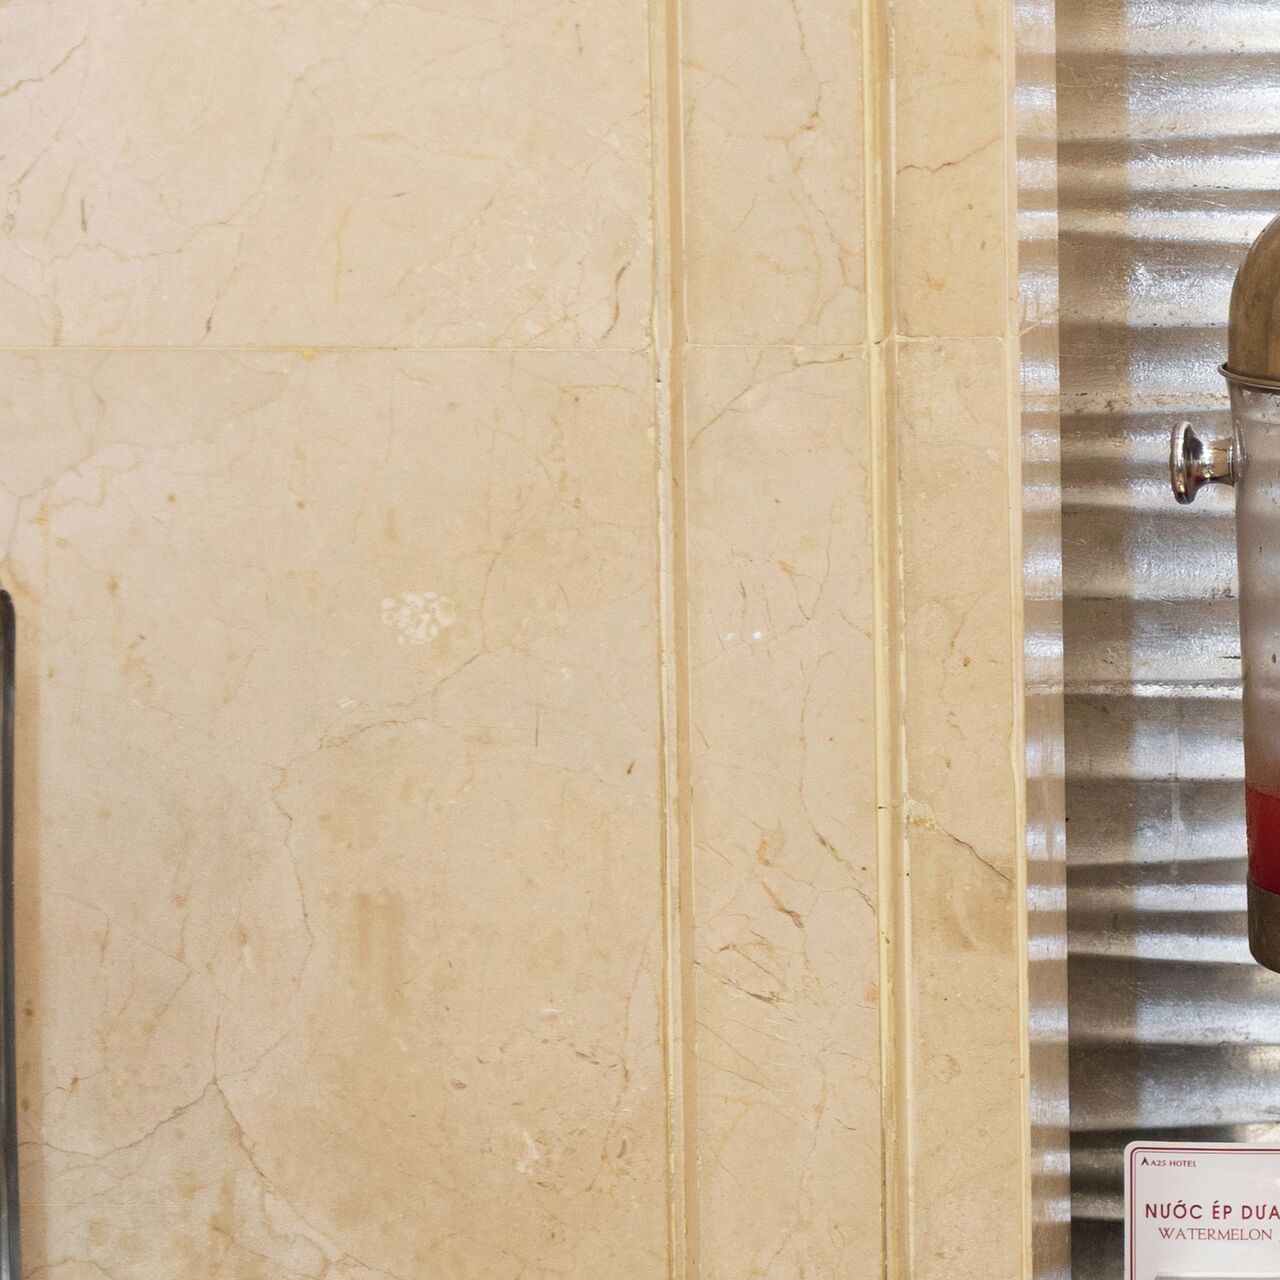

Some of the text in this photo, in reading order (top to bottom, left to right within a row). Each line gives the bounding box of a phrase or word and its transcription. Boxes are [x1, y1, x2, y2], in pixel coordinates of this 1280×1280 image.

[1145, 1200, 1203, 1220] NƯỚC
[1212, 1200, 1233, 1220] ÉP
[1242, 1204, 1280, 1220] DƯA
[1158, 1227, 1273, 1241] WATERMELON
